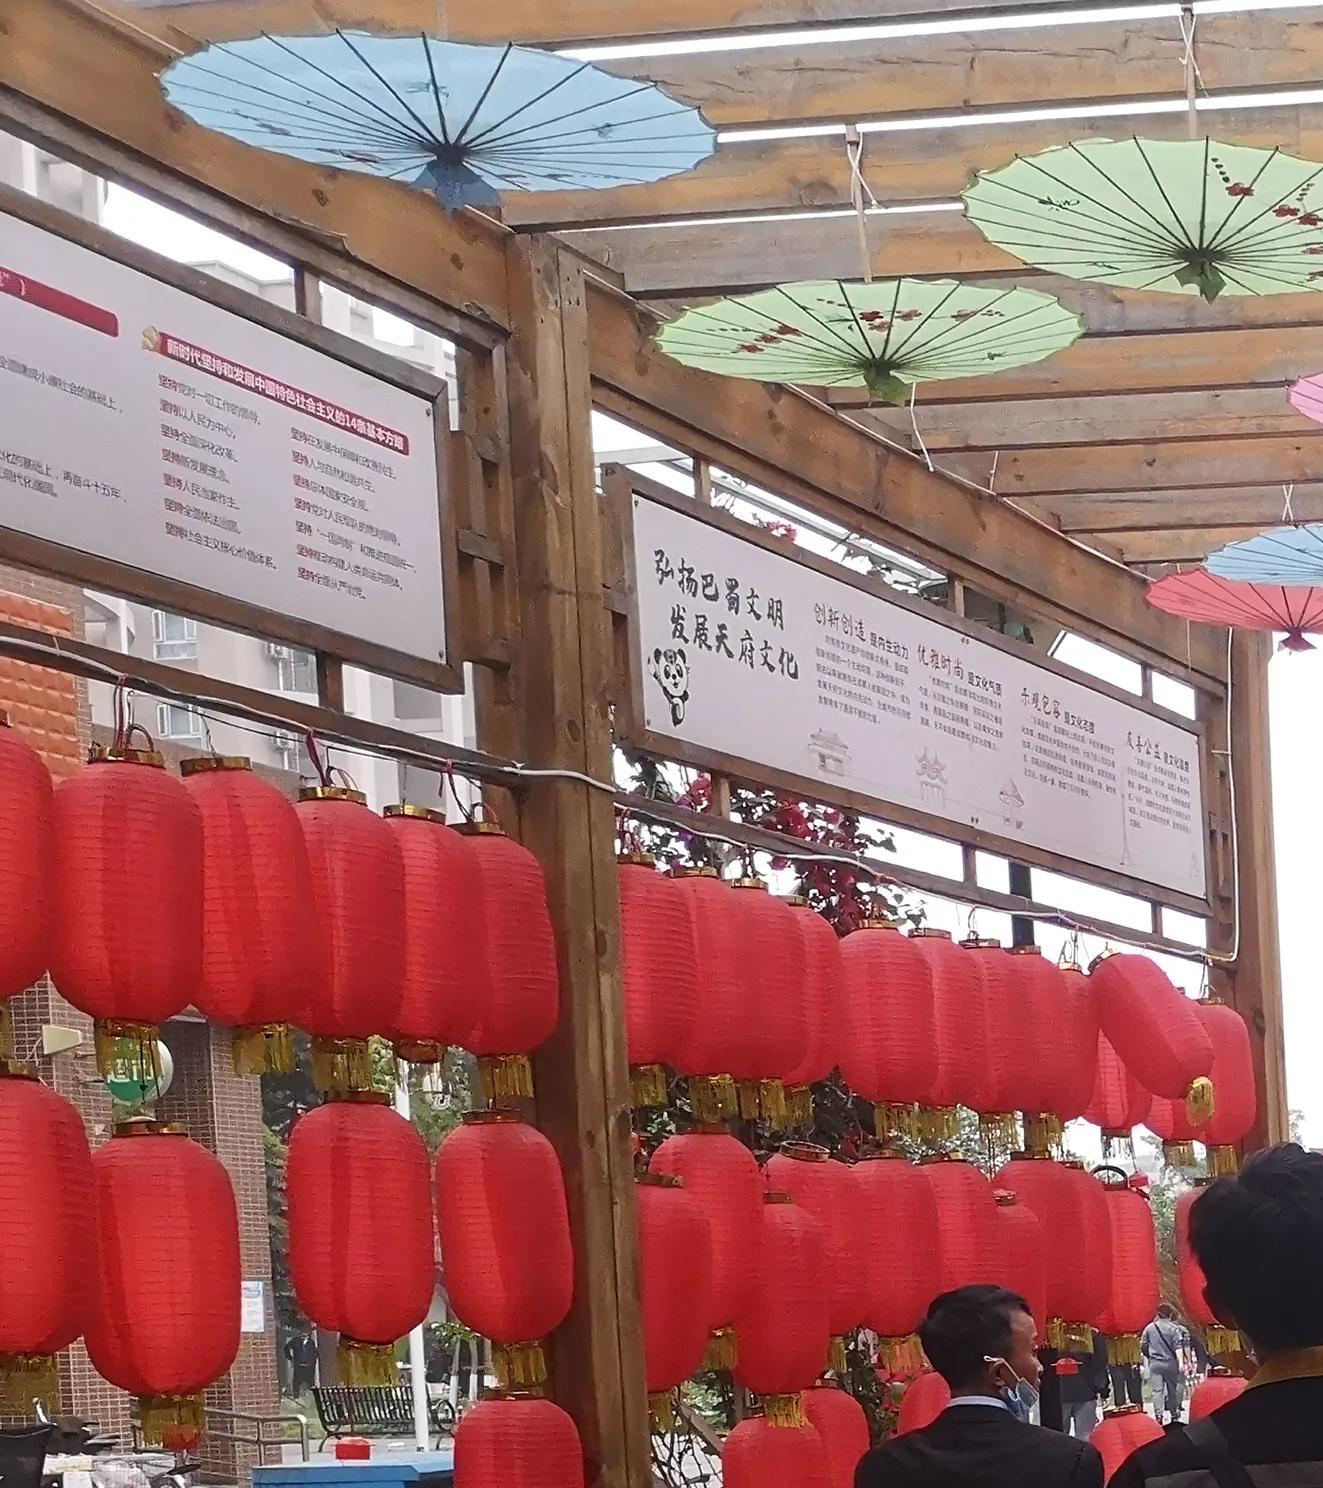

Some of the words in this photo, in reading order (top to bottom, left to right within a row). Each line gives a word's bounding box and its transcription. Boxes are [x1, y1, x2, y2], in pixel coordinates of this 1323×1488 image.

[654, 549, 784, 631] 弘扬巴蜀文明
[670, 603, 799, 680] 发展天府文化
